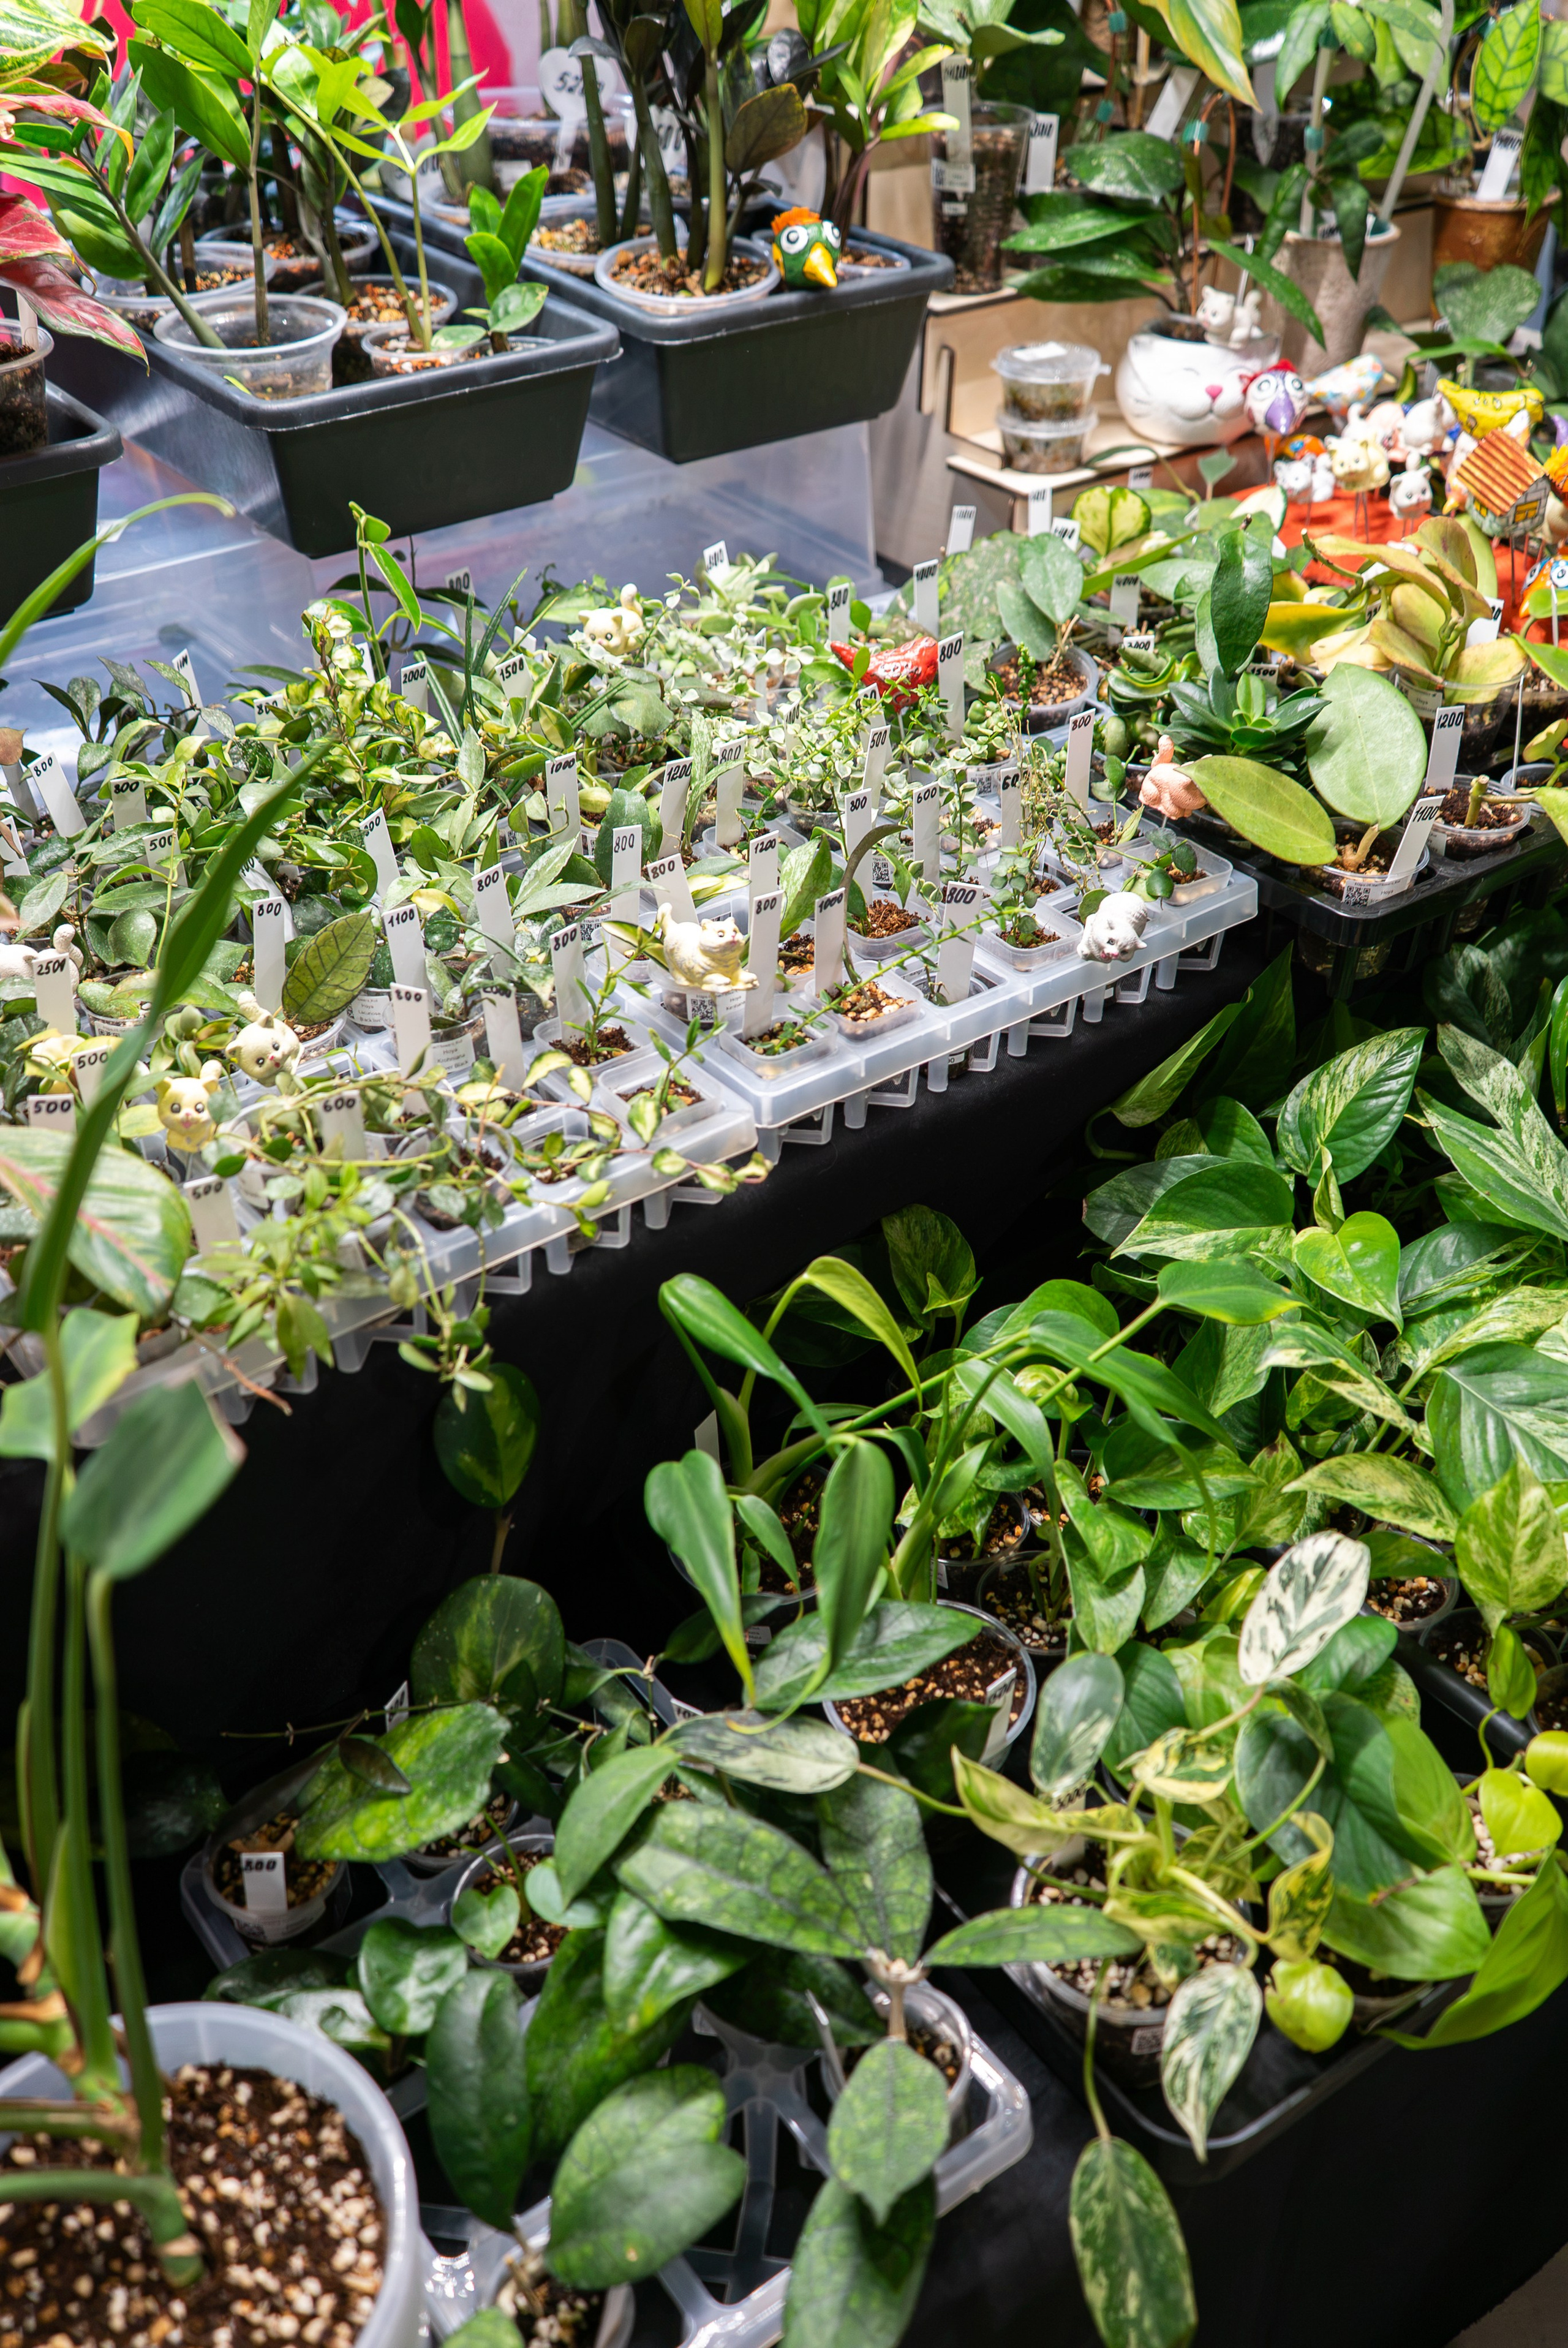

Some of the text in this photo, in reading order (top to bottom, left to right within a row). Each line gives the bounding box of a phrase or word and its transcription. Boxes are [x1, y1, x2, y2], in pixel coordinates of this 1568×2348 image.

[938, 638, 962, 663] 800
[402, 665, 426, 684] 2000
[499, 657, 524, 681] 1500
[1071, 714, 1091, 731] 800
[1436, 711, 1464, 729] 1200
[869, 730, 888, 749] 500
[33, 757, 53, 777] 800
[550, 757, 575, 774] 1000
[666, 761, 692, 782] 1200
[113, 780, 140, 795] 800
[916, 787, 937, 804] 600
[850, 796, 867, 812] 800
[1412, 806, 1439, 823] 1100
[613, 833, 635, 853] 800
[754, 837, 777, 854] 1200
[650, 859, 676, 879] 800
[477, 870, 500, 892] 800
[818, 893, 843, 913] 1000
[946, 886, 977, 905] 800
[257, 902, 282, 916] 800
[756, 896, 777, 915] 800
[388, 908, 415, 927] 1100
[554, 927, 577, 951] 800
[37, 957, 66, 975] 2500
[77, 1052, 108, 1070] 500
[34, 1099, 72, 1114] 500
[323, 1097, 356, 1112] 600
